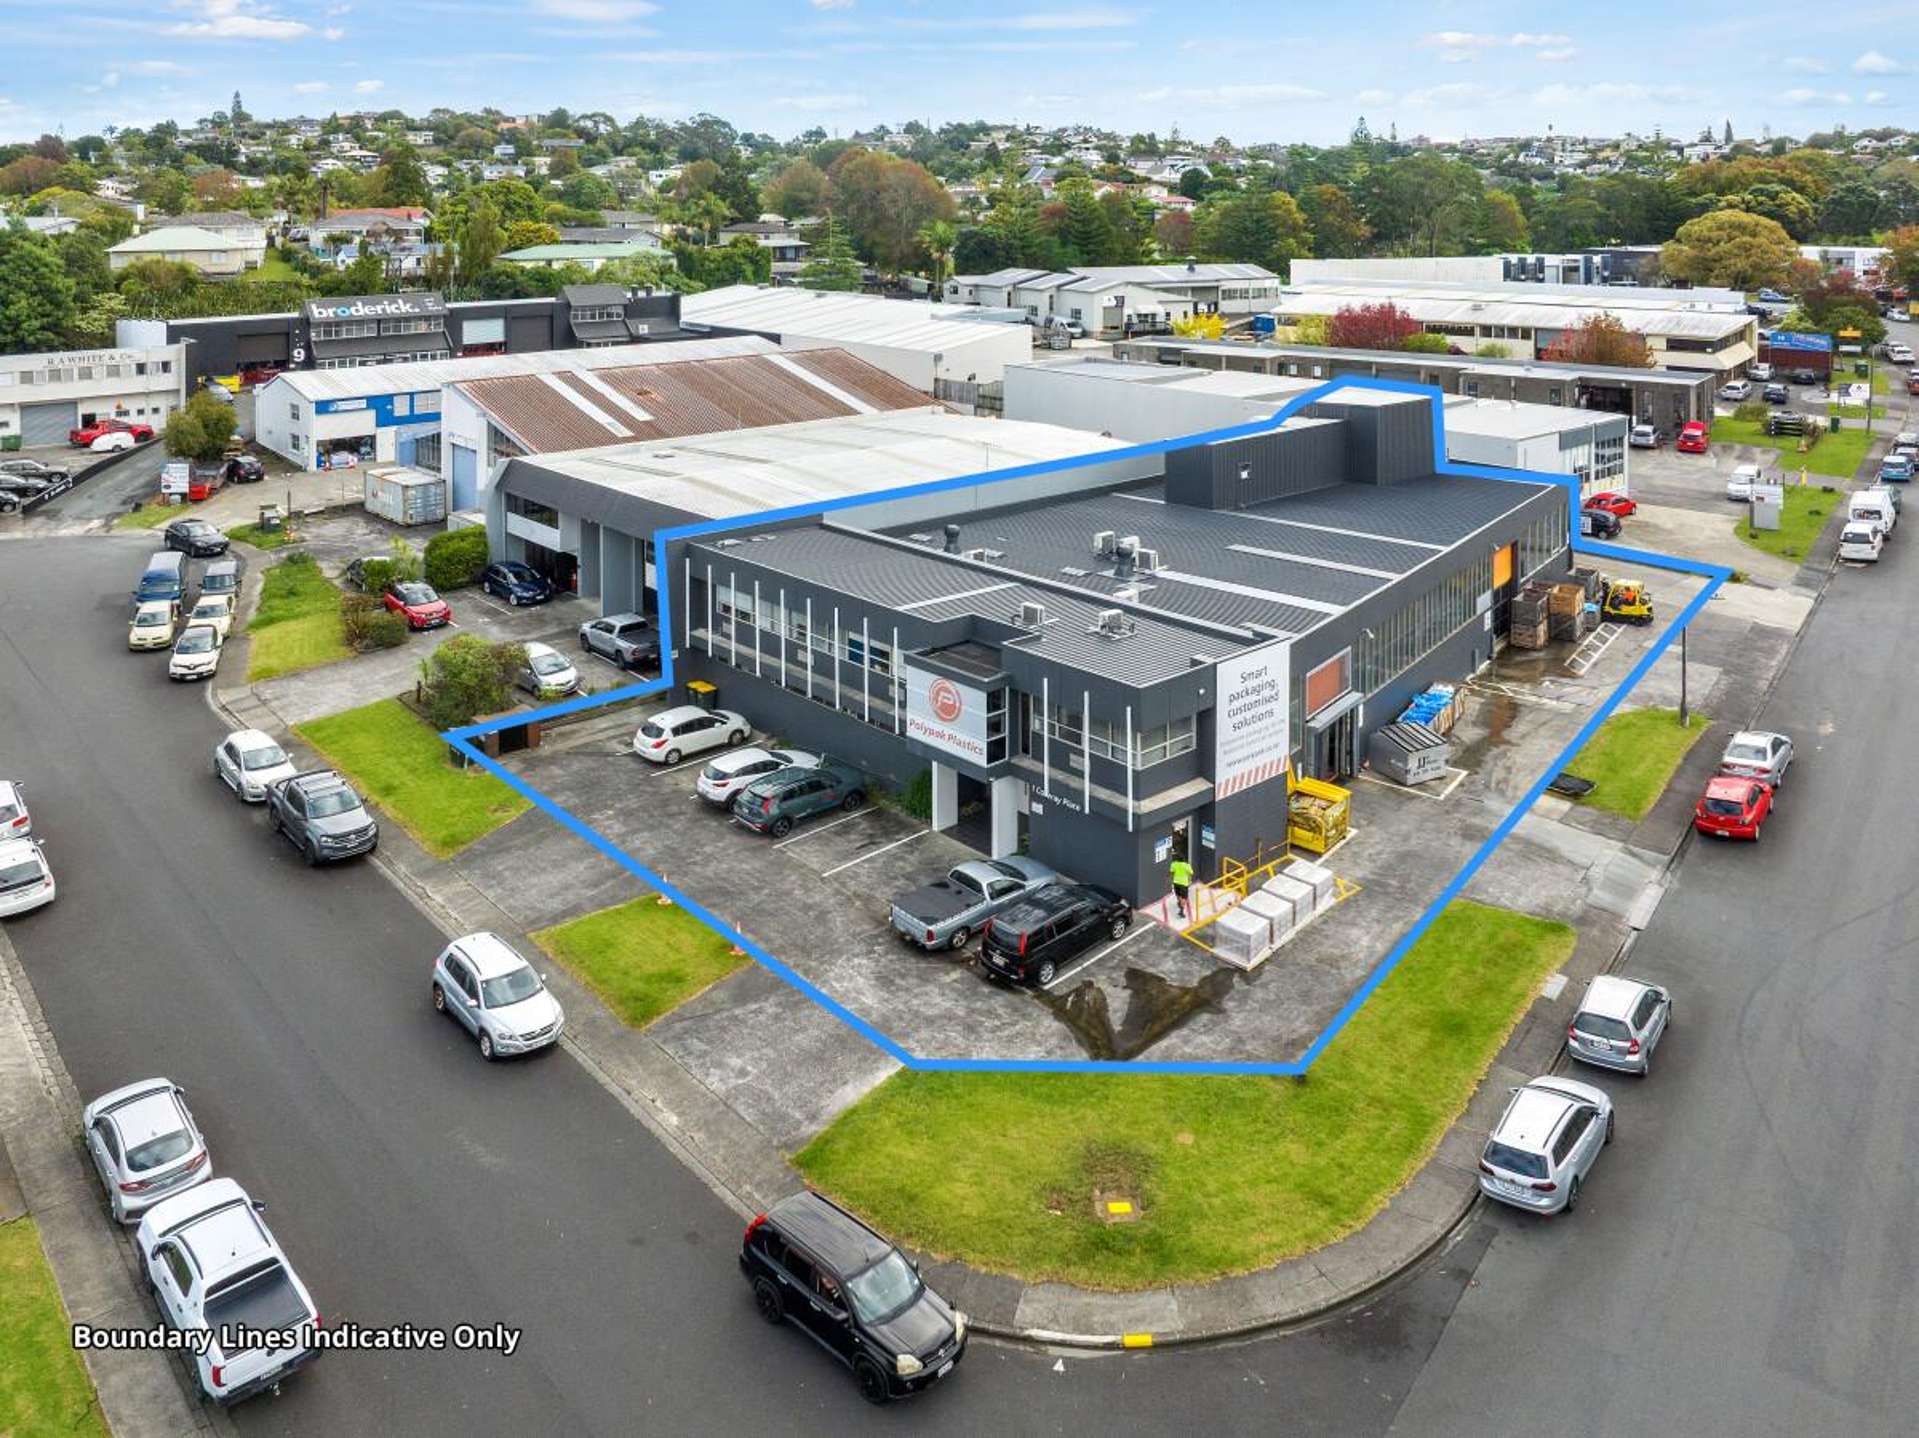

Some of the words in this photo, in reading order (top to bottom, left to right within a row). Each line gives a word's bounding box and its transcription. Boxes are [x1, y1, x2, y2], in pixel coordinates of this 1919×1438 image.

[293, 348, 305, 362] 9
[1240, 666, 1268, 684] Smart
[1227, 690, 1280, 719] customised
[1232, 708, 1274, 732] solutions
[909, 718, 947, 741] Polypak
[947, 732, 984, 756] Plastics
[1063, 797, 1081, 812] Place
